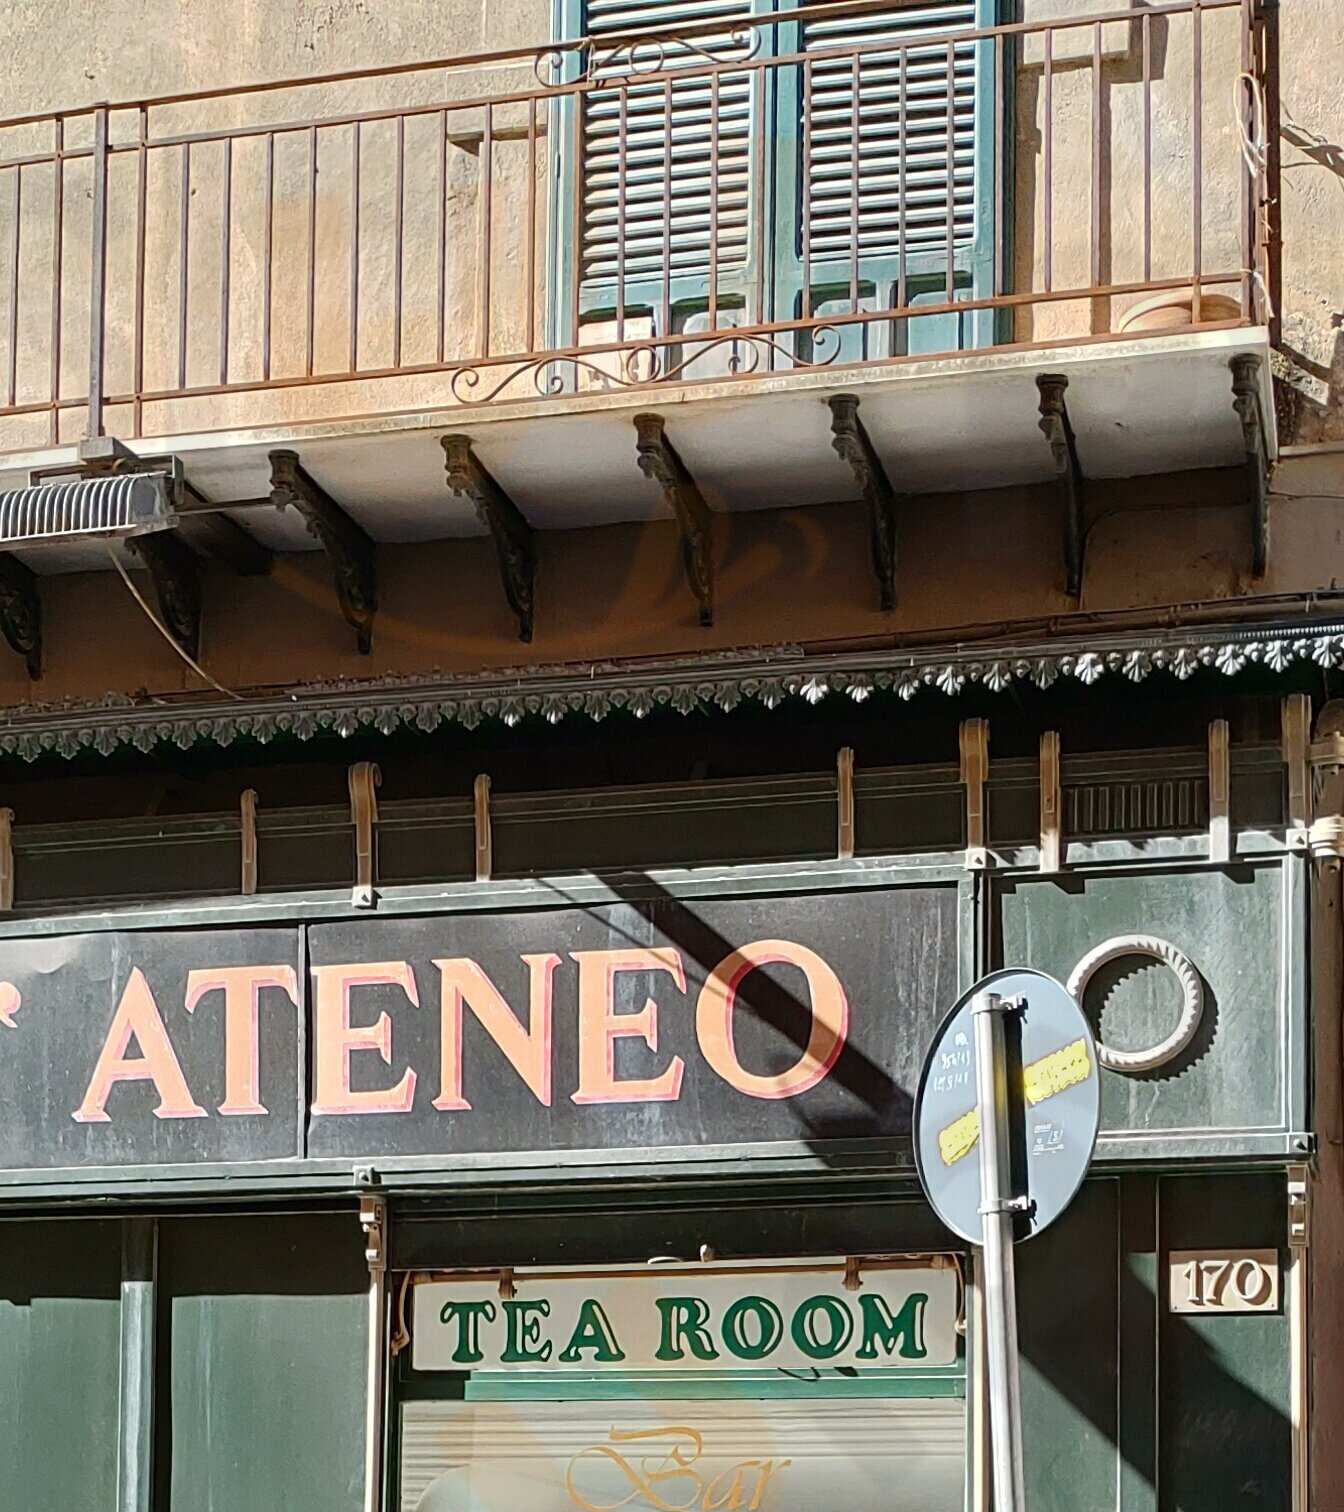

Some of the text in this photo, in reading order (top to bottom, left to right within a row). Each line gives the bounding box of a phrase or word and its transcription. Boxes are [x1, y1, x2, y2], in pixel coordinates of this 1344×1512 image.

[70, 939, 850, 1123] ATENEO
[1182, 1258, 1270, 1306] 170
[440, 1292, 929, 1364] TEA ROOM
[567, 1423, 792, 1512] Bar
